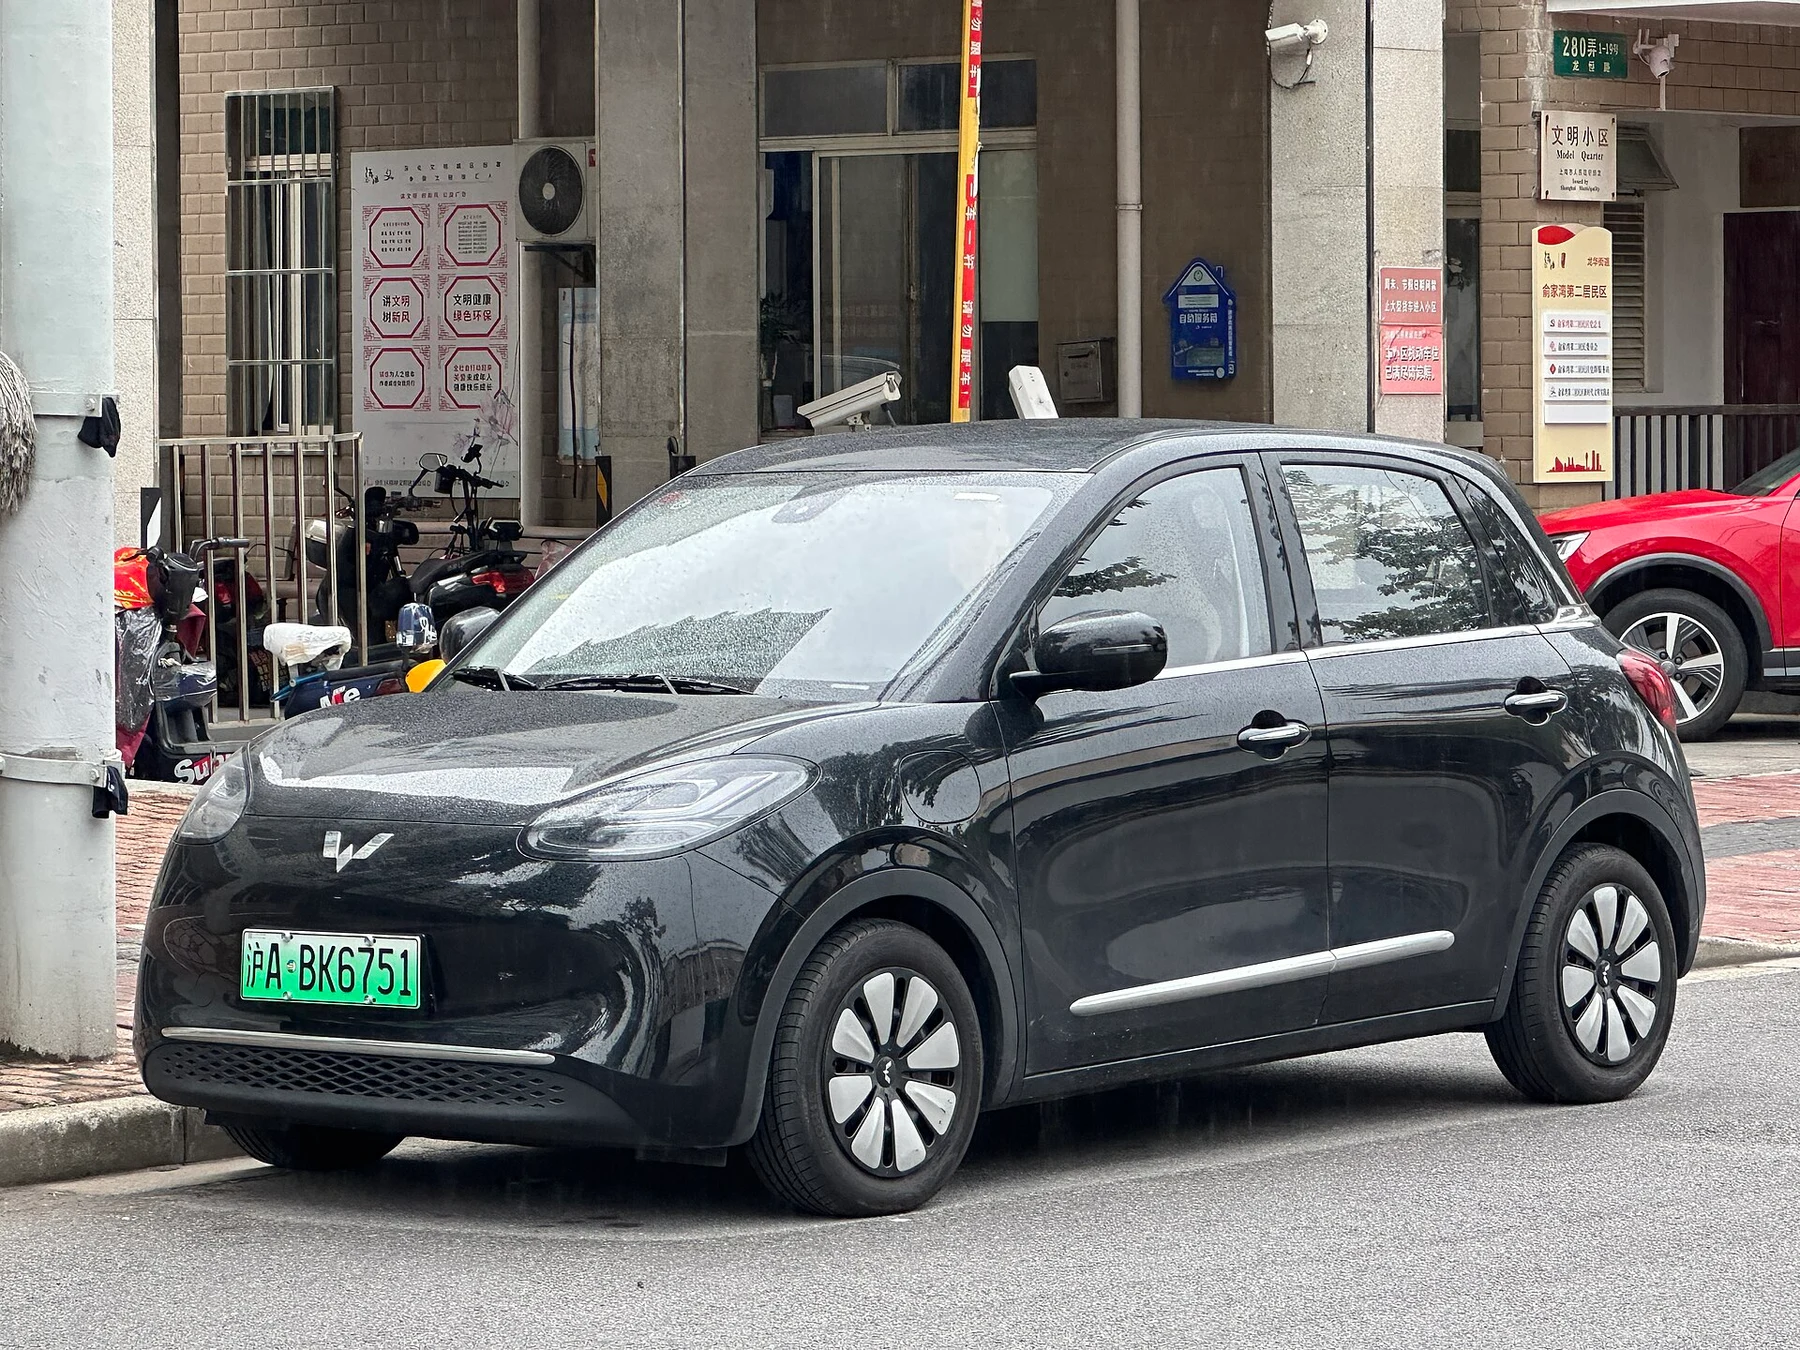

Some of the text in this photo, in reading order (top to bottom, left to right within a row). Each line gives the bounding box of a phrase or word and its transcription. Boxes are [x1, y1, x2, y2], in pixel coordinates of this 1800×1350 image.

[1562, 35, 1597, 57] 280弄
[1551, 125, 1609, 147] 文明小区
[1556, 149, 1604, 162] Model Quarter
[1542, 283, 1608, 298] 俞家湾第二居民区
[382, 294, 410, 307] 讲文明
[453, 293, 492, 306] 文明健康
[382, 310, 410, 323] 树新风
[453, 309, 492, 322] 绿色环保
[299, 943, 412, 997] BK6751
